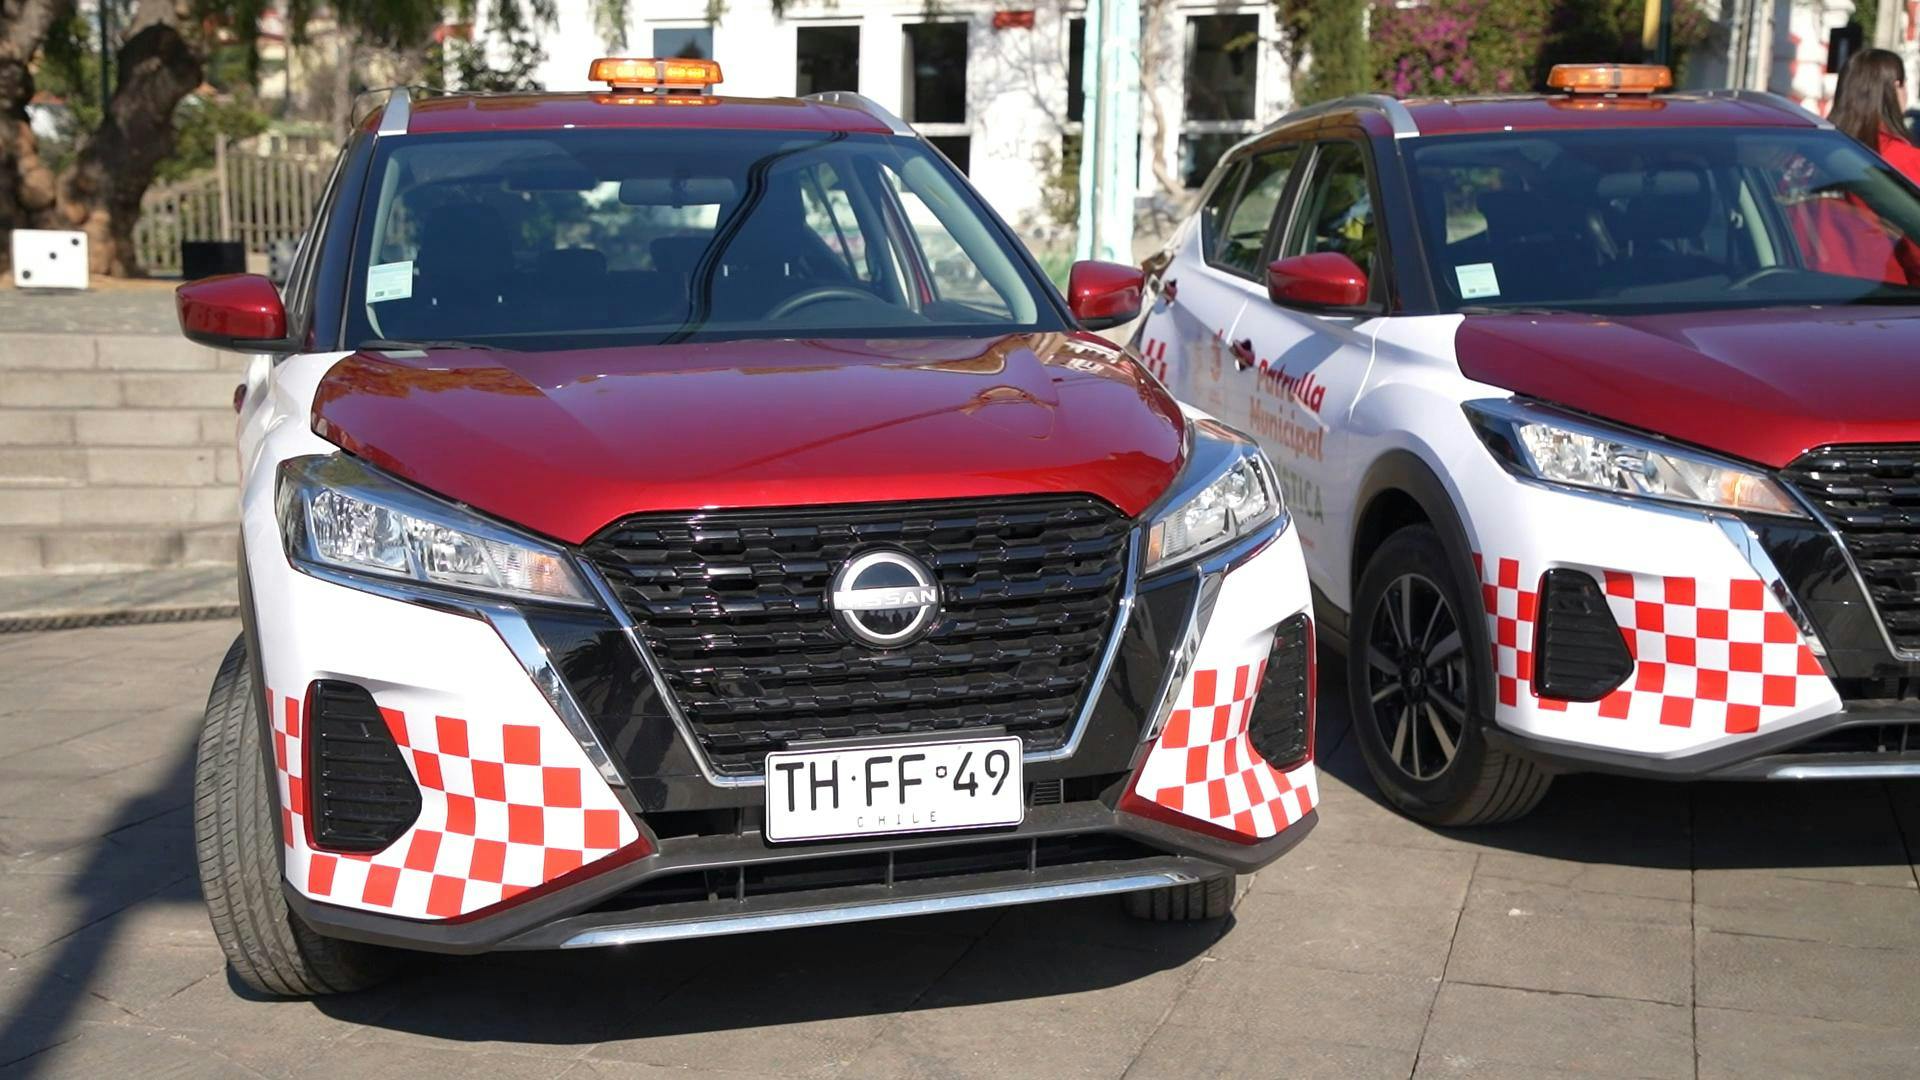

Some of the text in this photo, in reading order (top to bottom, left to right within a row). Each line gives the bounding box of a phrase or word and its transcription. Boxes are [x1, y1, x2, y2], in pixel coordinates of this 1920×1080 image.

[1257, 359, 1326, 413] Patrulla
[1250, 396, 1323, 461] Municipal
[840, 588, 937, 608] SSAN
[856, 811, 938, 828] CHILE
